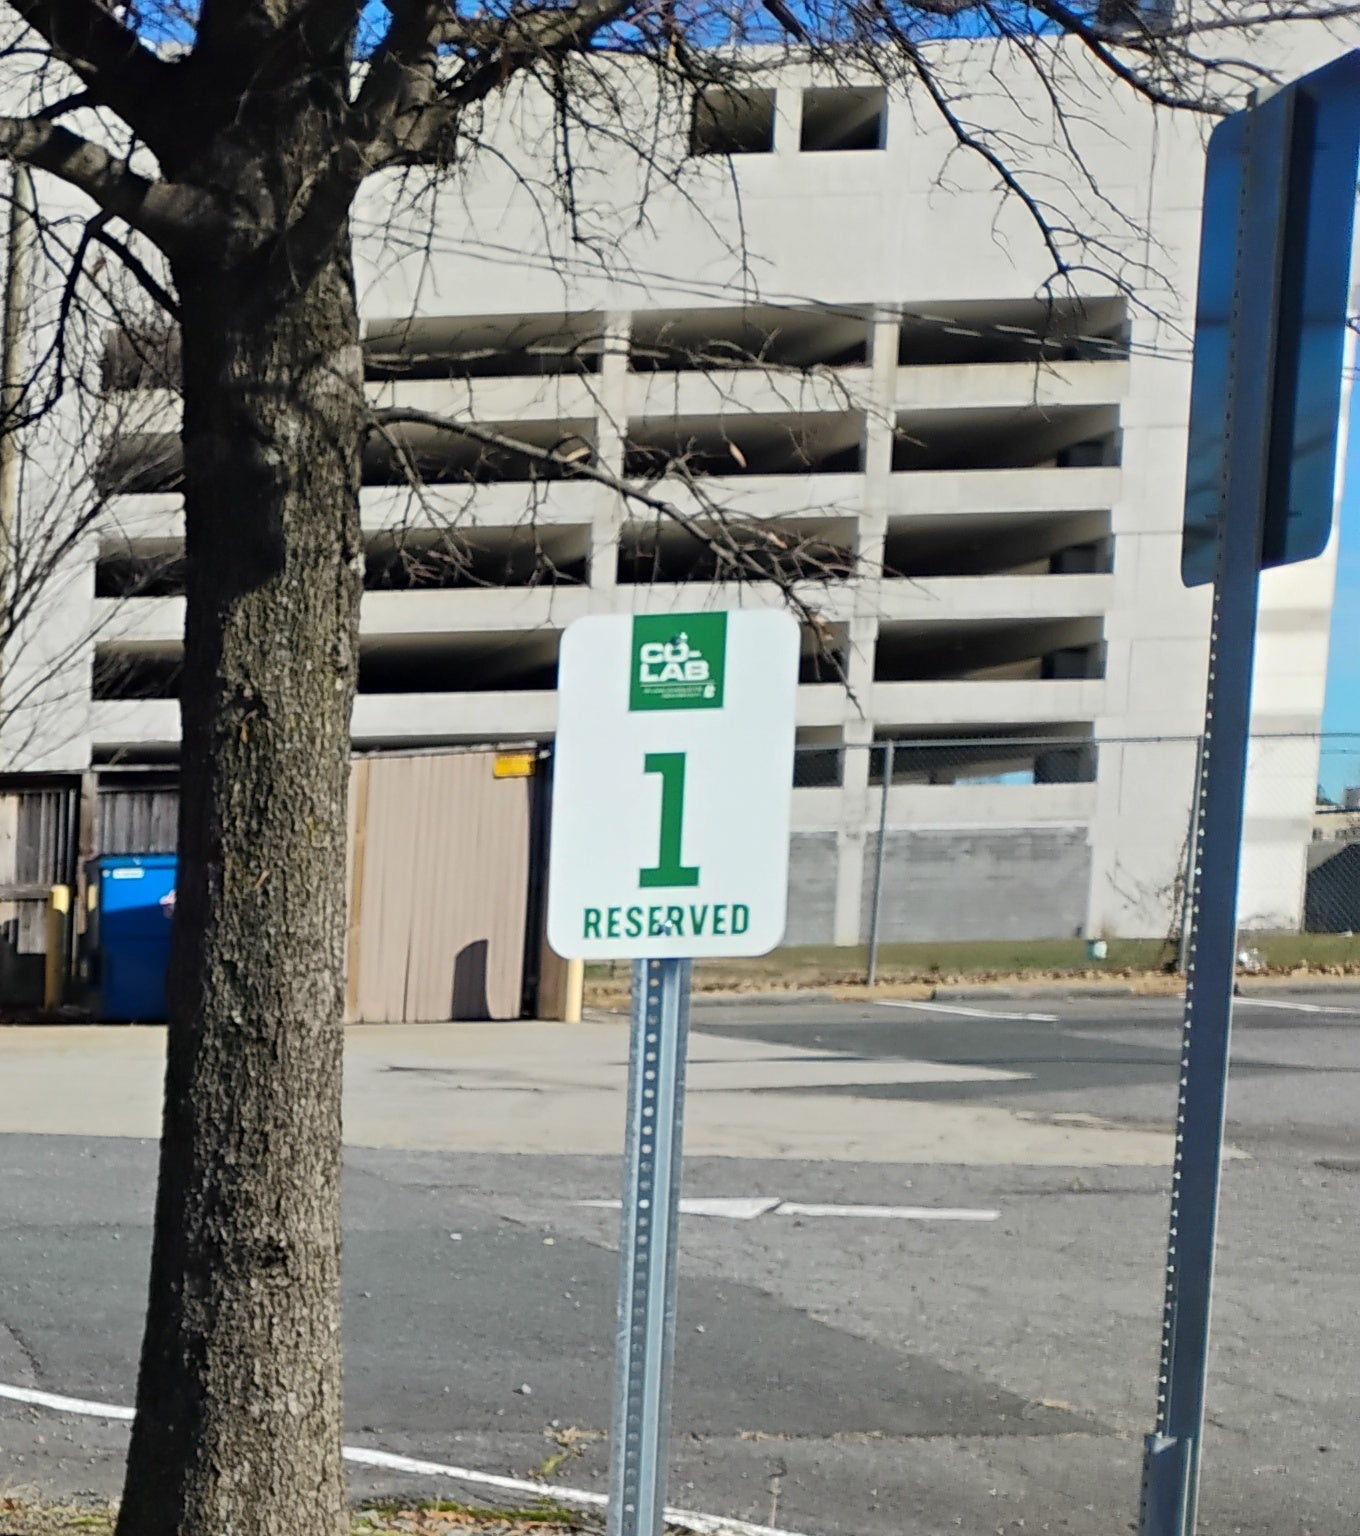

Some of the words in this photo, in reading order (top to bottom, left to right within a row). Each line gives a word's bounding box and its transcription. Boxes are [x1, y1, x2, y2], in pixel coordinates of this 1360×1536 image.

[640, 642, 702, 664] CO-
[639, 660, 710, 683] LAB
[638, 751, 701, 888] 1
[582, 903, 751, 939] RESERVED
